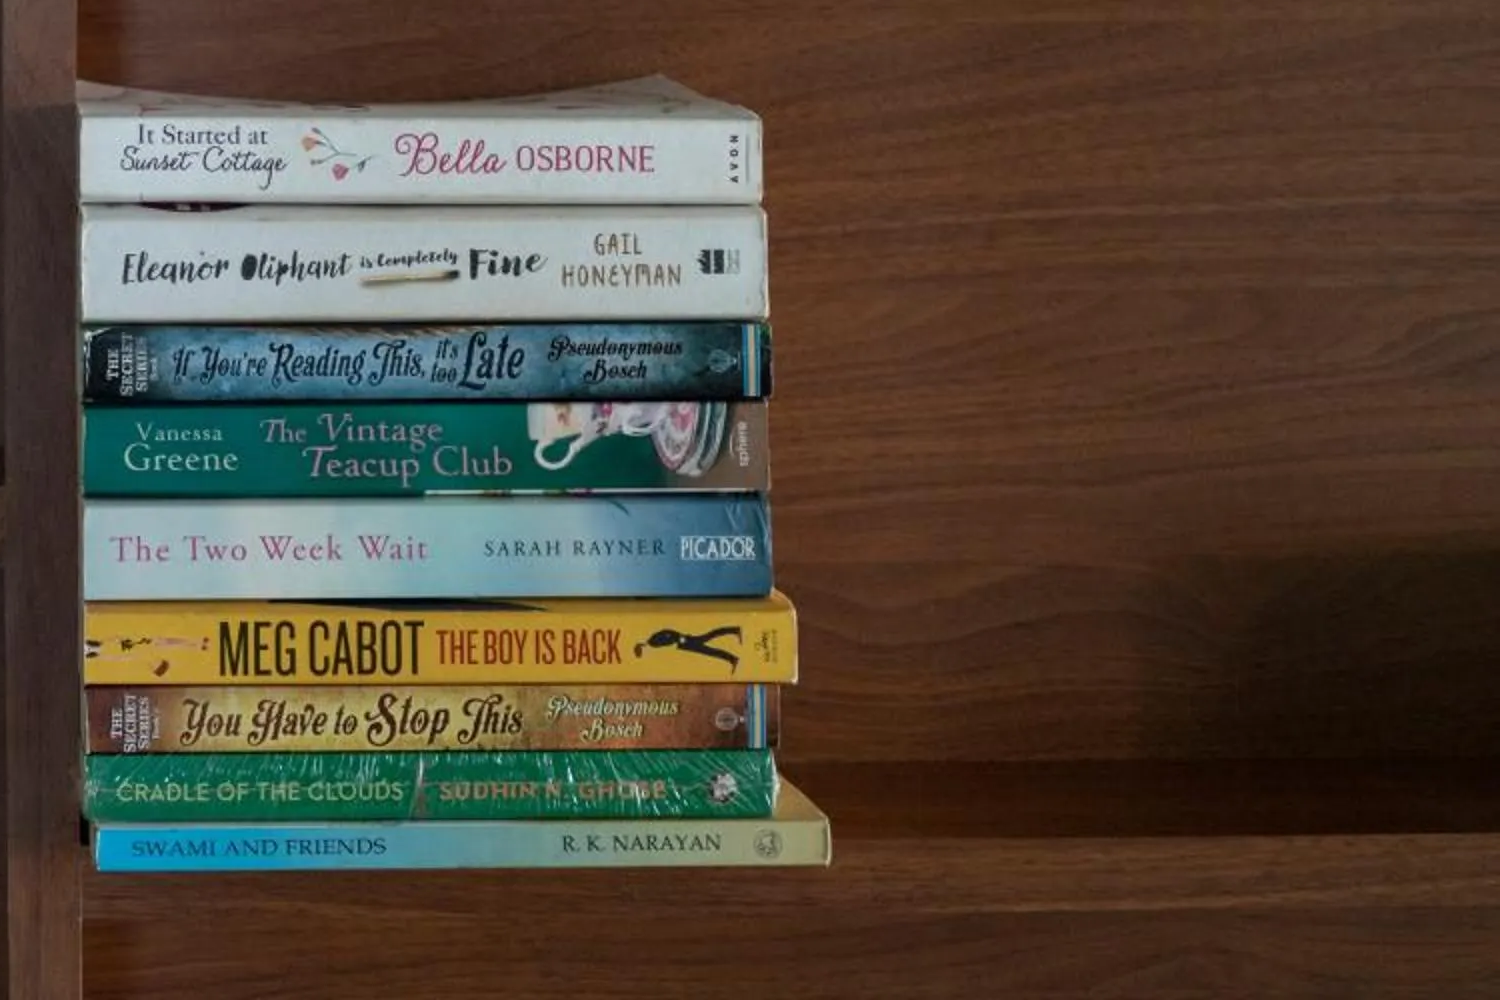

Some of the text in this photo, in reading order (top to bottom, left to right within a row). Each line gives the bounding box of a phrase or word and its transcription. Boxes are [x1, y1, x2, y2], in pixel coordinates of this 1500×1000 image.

[138, 123, 269, 145] It Started at
[120, 145, 288, 190] Sunset Cottage
[394, 131, 655, 177] Bella OSBORNE
[593, 232, 643, 256] GAIL
[121, 250, 230, 285] Eleanor
[240, 250, 351, 287] Oliphant
[468, 247, 548, 281] Fine
[269, 341, 367, 389] Reading
[457, 331, 526, 390] Late
[548, 334, 684, 361] Pseudonymous
[582, 358, 647, 385] Bosch
[136, 421, 223, 443] Vanessa
[259, 412, 443, 453] The Vintage
[123, 442, 239, 472] Greene
[302, 445, 513, 488] Teacup Club
[108, 534, 429, 562] The Two Week Wait
[483, 536, 757, 560] SARAH RAYNER PICADOR
[218, 620, 622, 677] MEG CABOT THE BOY IS BACK
[180, 698, 241, 746] You
[247, 698, 329, 746] Have
[334, 705, 358, 736] to
[364, 692, 451, 746] Stop
[457, 693, 524, 745] This
[546, 694, 679, 720] Pseudonymous
[580, 717, 645, 740] Bosch
[116, 780, 405, 802] CRADLE OF THE CLOUDS
[131, 837, 388, 858] SWAMI AND FRIENDS
[562, 834, 722, 852] R. K. NARAYAN
